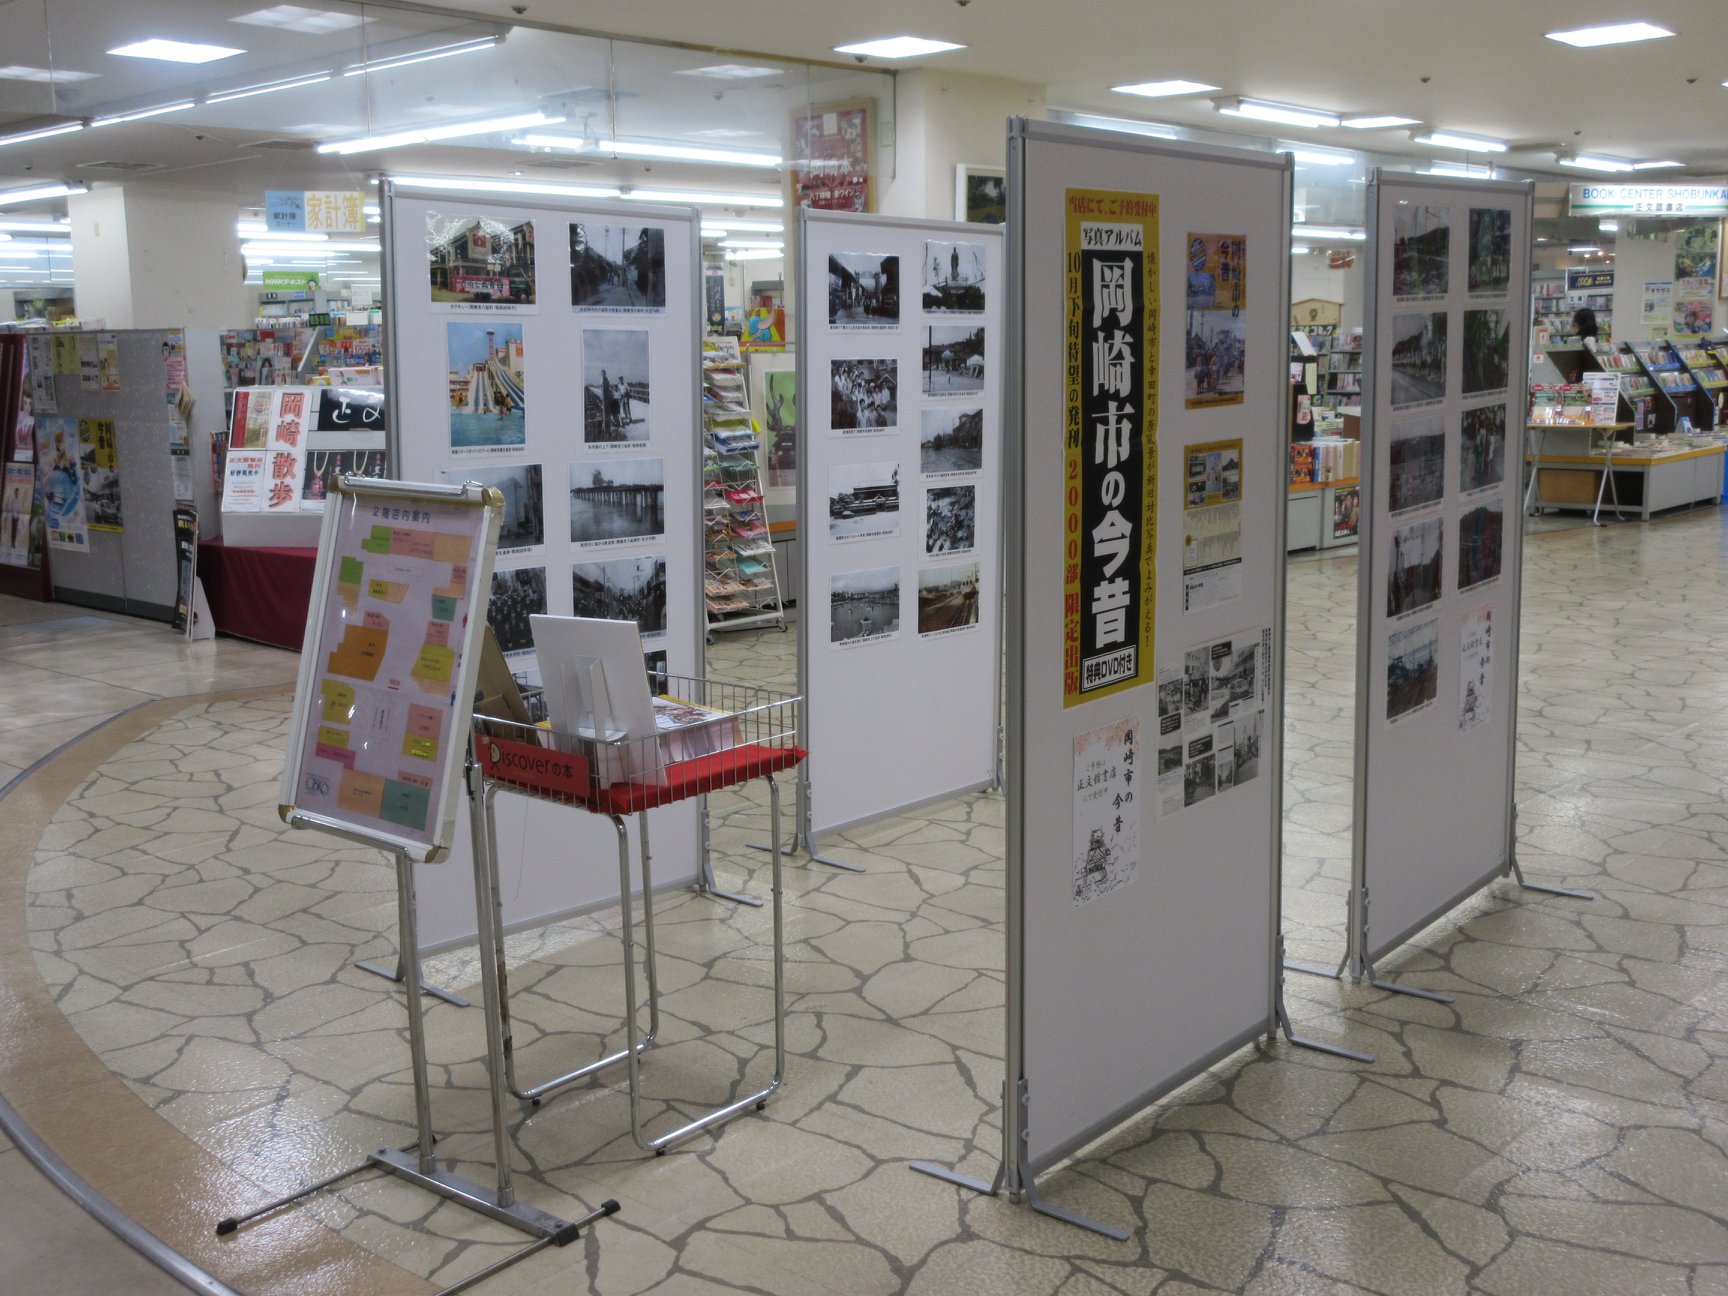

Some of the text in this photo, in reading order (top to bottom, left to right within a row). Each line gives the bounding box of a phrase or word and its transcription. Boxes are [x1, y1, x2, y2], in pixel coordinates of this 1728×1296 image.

[306, 194, 361, 230] 家計簿
[1583, 188, 1614, 199] BOOK
[1620, 188, 1662, 200] CENTER
[1082, 227, 1142, 247] 写真アルバム
[1067, 252, 1081, 449] 10月下旬待望の発刊
[268, 391, 306, 509] 岡崎散歩
[1091, 256, 1135, 650] 岡崎市の今昔
[372, 506, 431, 524] 2階店内案内
[1064, 592, 1080, 696] 限定出版
[1085, 651, 1134, 686] 特典DVD付き
[1123, 728, 1134, 803] 岡崎市の
[1111, 792, 1124, 832] 今昔
